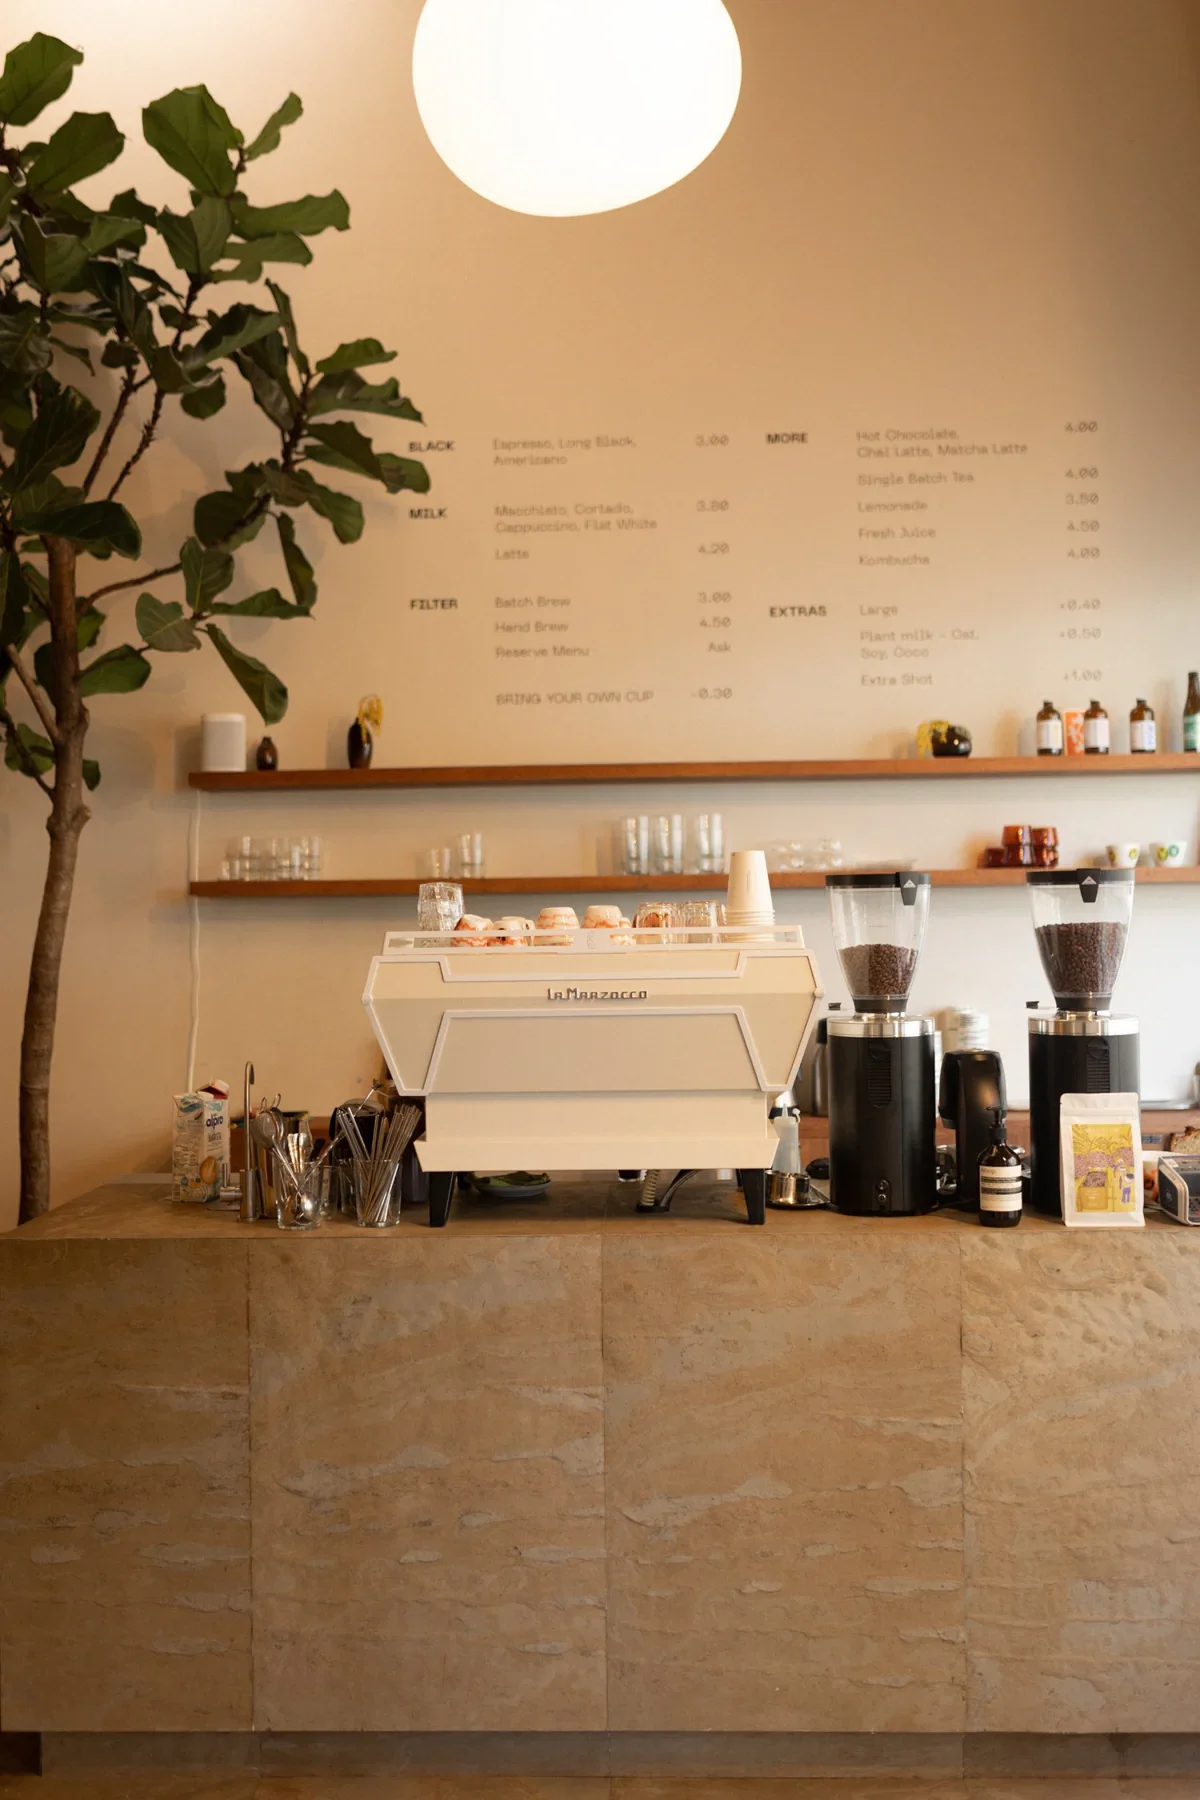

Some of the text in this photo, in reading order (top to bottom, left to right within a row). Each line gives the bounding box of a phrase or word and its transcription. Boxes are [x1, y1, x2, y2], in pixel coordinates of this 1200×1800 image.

[1064, 421, 1098, 433] 4.00
[695, 434, 730, 447] 3.00
[765, 432, 809, 444] MORE
[856, 428, 960, 442] Hot Chocolate,
[408, 440, 455, 452] BLACK
[493, 435, 637, 451] Espresso, Long Black,
[857, 443, 1028, 458] Chai Latte, Matcha Latte
[493, 455, 567, 466] Americano
[857, 471, 975, 487] Single Batch Tea
[1065, 467, 1099, 480] 4.00
[409, 507, 447, 519] MILK
[494, 502, 634, 517] Macchiato, Cortado,
[858, 500, 928, 513] Lemonade
[494, 518, 658, 535] Cappuccino, Flat White
[1066, 519, 1101, 532] 4.50
[858, 526, 936, 539] Fresh Juice
[494, 549, 529, 560] Latte
[697, 542, 730, 555] 4.20
[1066, 547, 1101, 559] 4.00
[858, 553, 930, 566] Kombucha
[410, 597, 458, 610] FILTER
[495, 596, 571, 609] Batch Brew
[698, 591, 732, 604] 3.00
[769, 605, 828, 618] EXTRAS
[859, 603, 899, 618] Large
[494, 620, 569, 633] Hand Brew
[699, 616, 732, 628] 4.50
[860, 629, 896, 642] Plant
[900, 628, 933, 641] milk
[495, 645, 590, 659] Reserve Menu
[708, 641, 731, 653] Ask
[860, 645, 930, 660] Soy, Coco
[860, 673, 933, 686] Extra Shot
[496, 690, 655, 705] BRING YOUR OWN CUP
[205, 1113, 224, 1130] alpro
